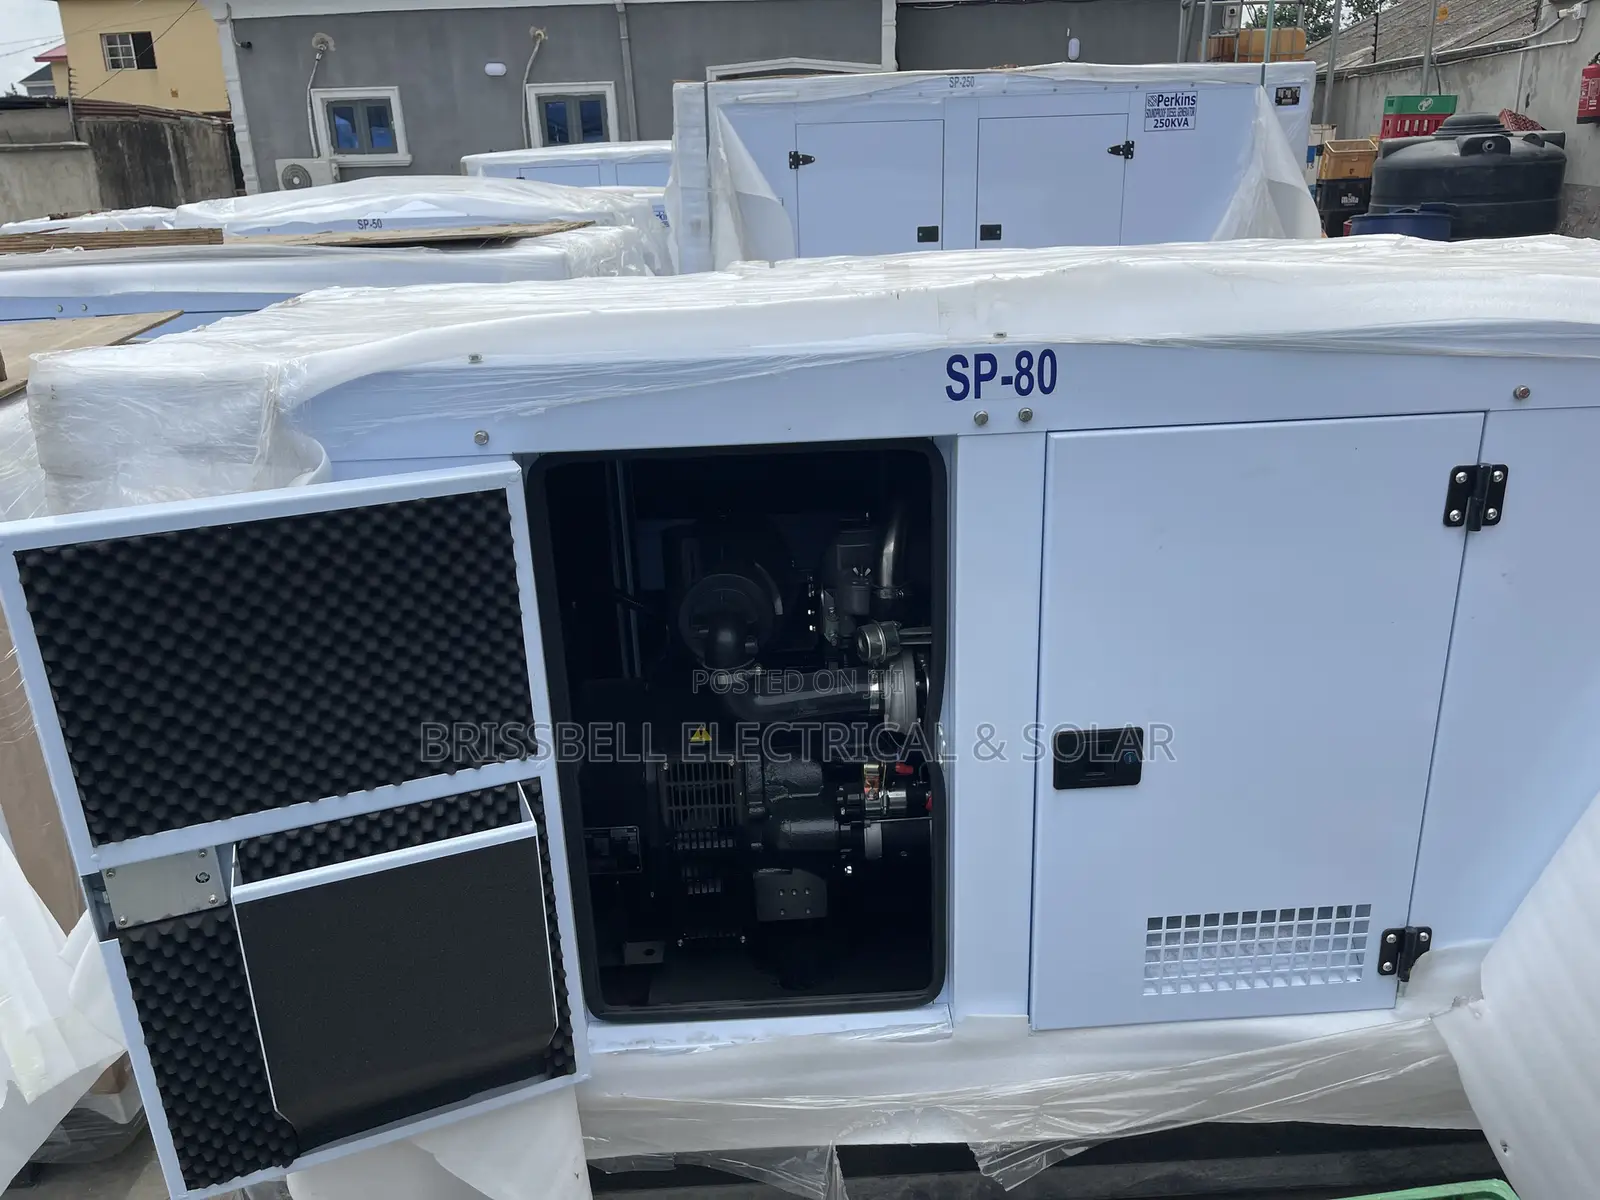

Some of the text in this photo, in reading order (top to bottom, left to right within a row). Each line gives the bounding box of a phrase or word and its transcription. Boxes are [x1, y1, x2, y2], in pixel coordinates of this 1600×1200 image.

[949, 76, 975, 88] SP-250
[1157, 93, 1196, 107] Perkins
[1153, 118, 1189, 129] 250KVA
[357, 218, 383, 230] SP-50
[945, 348, 1057, 401] SP-80
